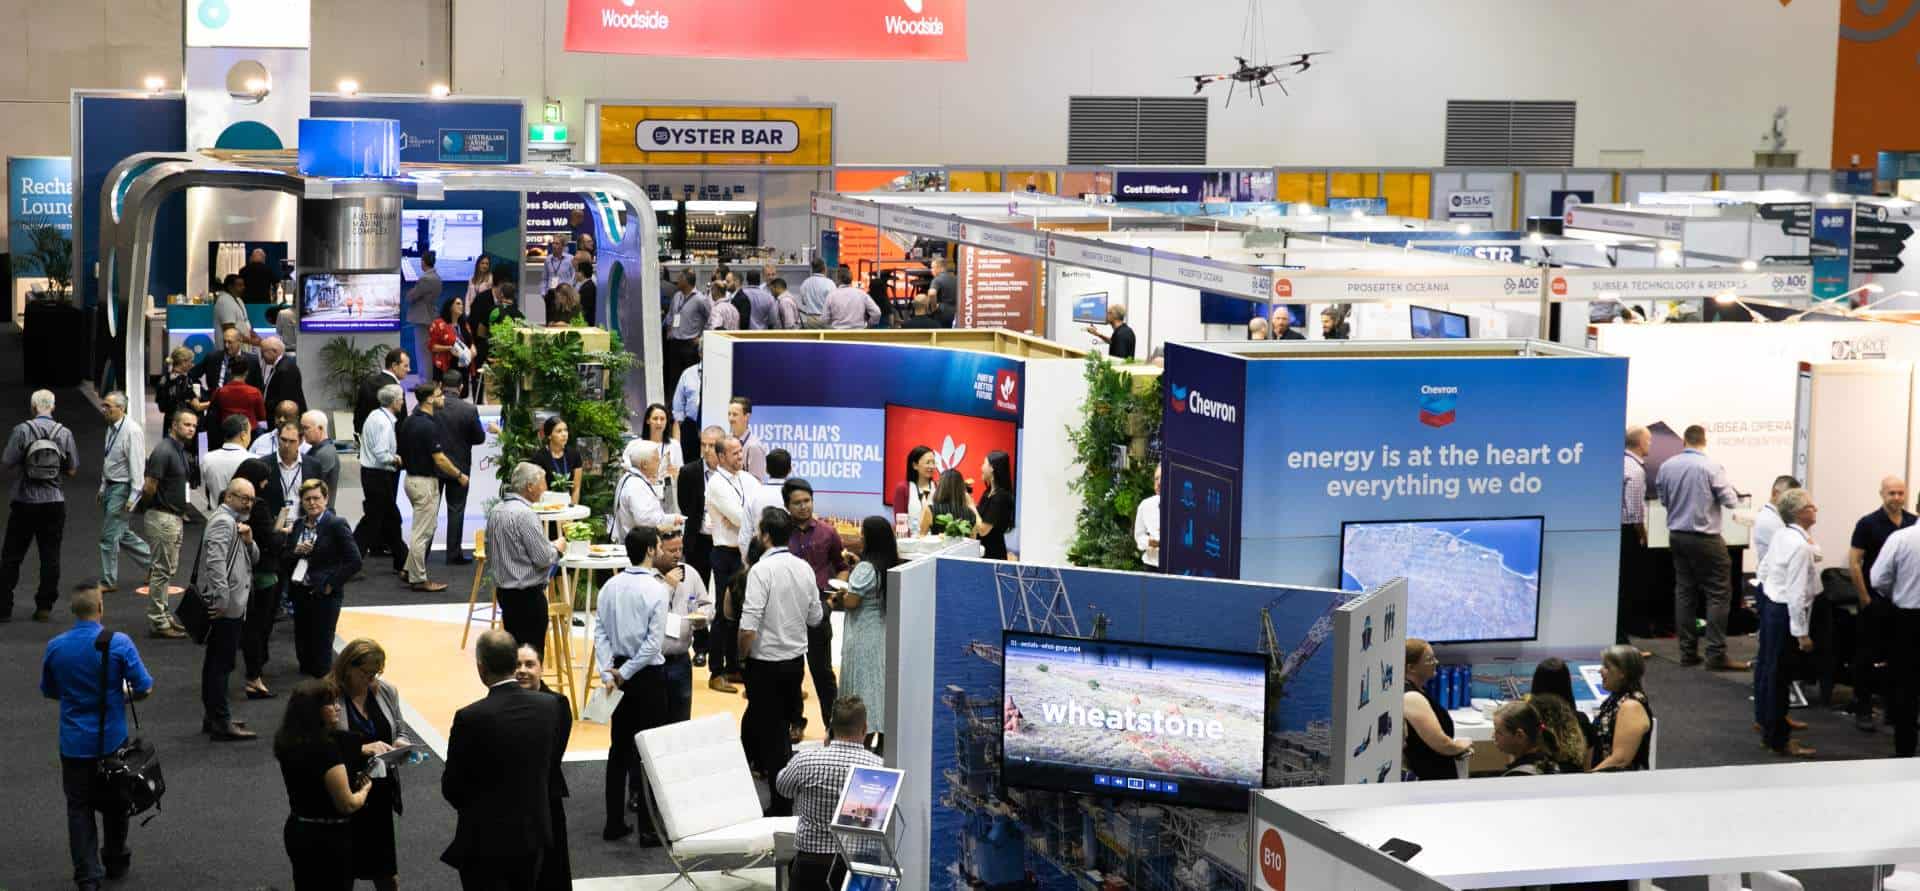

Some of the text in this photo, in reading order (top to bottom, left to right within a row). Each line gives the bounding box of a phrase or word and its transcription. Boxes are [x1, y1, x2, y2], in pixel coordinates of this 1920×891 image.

[602, 8, 669, 29] Woodside
[884, 15, 944, 35] Woodside
[741, 128, 784, 145] BAR
[1123, 183, 1188, 194] Cost Effective &
[542, 201, 585, 210] Solutions
[1463, 195, 1491, 207] SMS
[1474, 246, 1514, 262] STR
[1347, 283, 1449, 292] PROSERTEK OCEANIA
[1518, 278, 1539, 289] AOG
[1593, 281, 1628, 290] SUBSEA
[1631, 280, 1697, 290] TECHNOLOGY
[1786, 275, 1807, 287] AOG
[1421, 385, 1458, 394] Chevron
[1189, 390, 1236, 423] Chevron
[812, 443, 883, 462] NATURAL
[1287, 442, 1584, 472] energy is at the heart of
[1327, 472, 1542, 500] everything we do
[1042, 699, 1225, 738] wheatstone
[1264, 847, 1282, 871] B10
